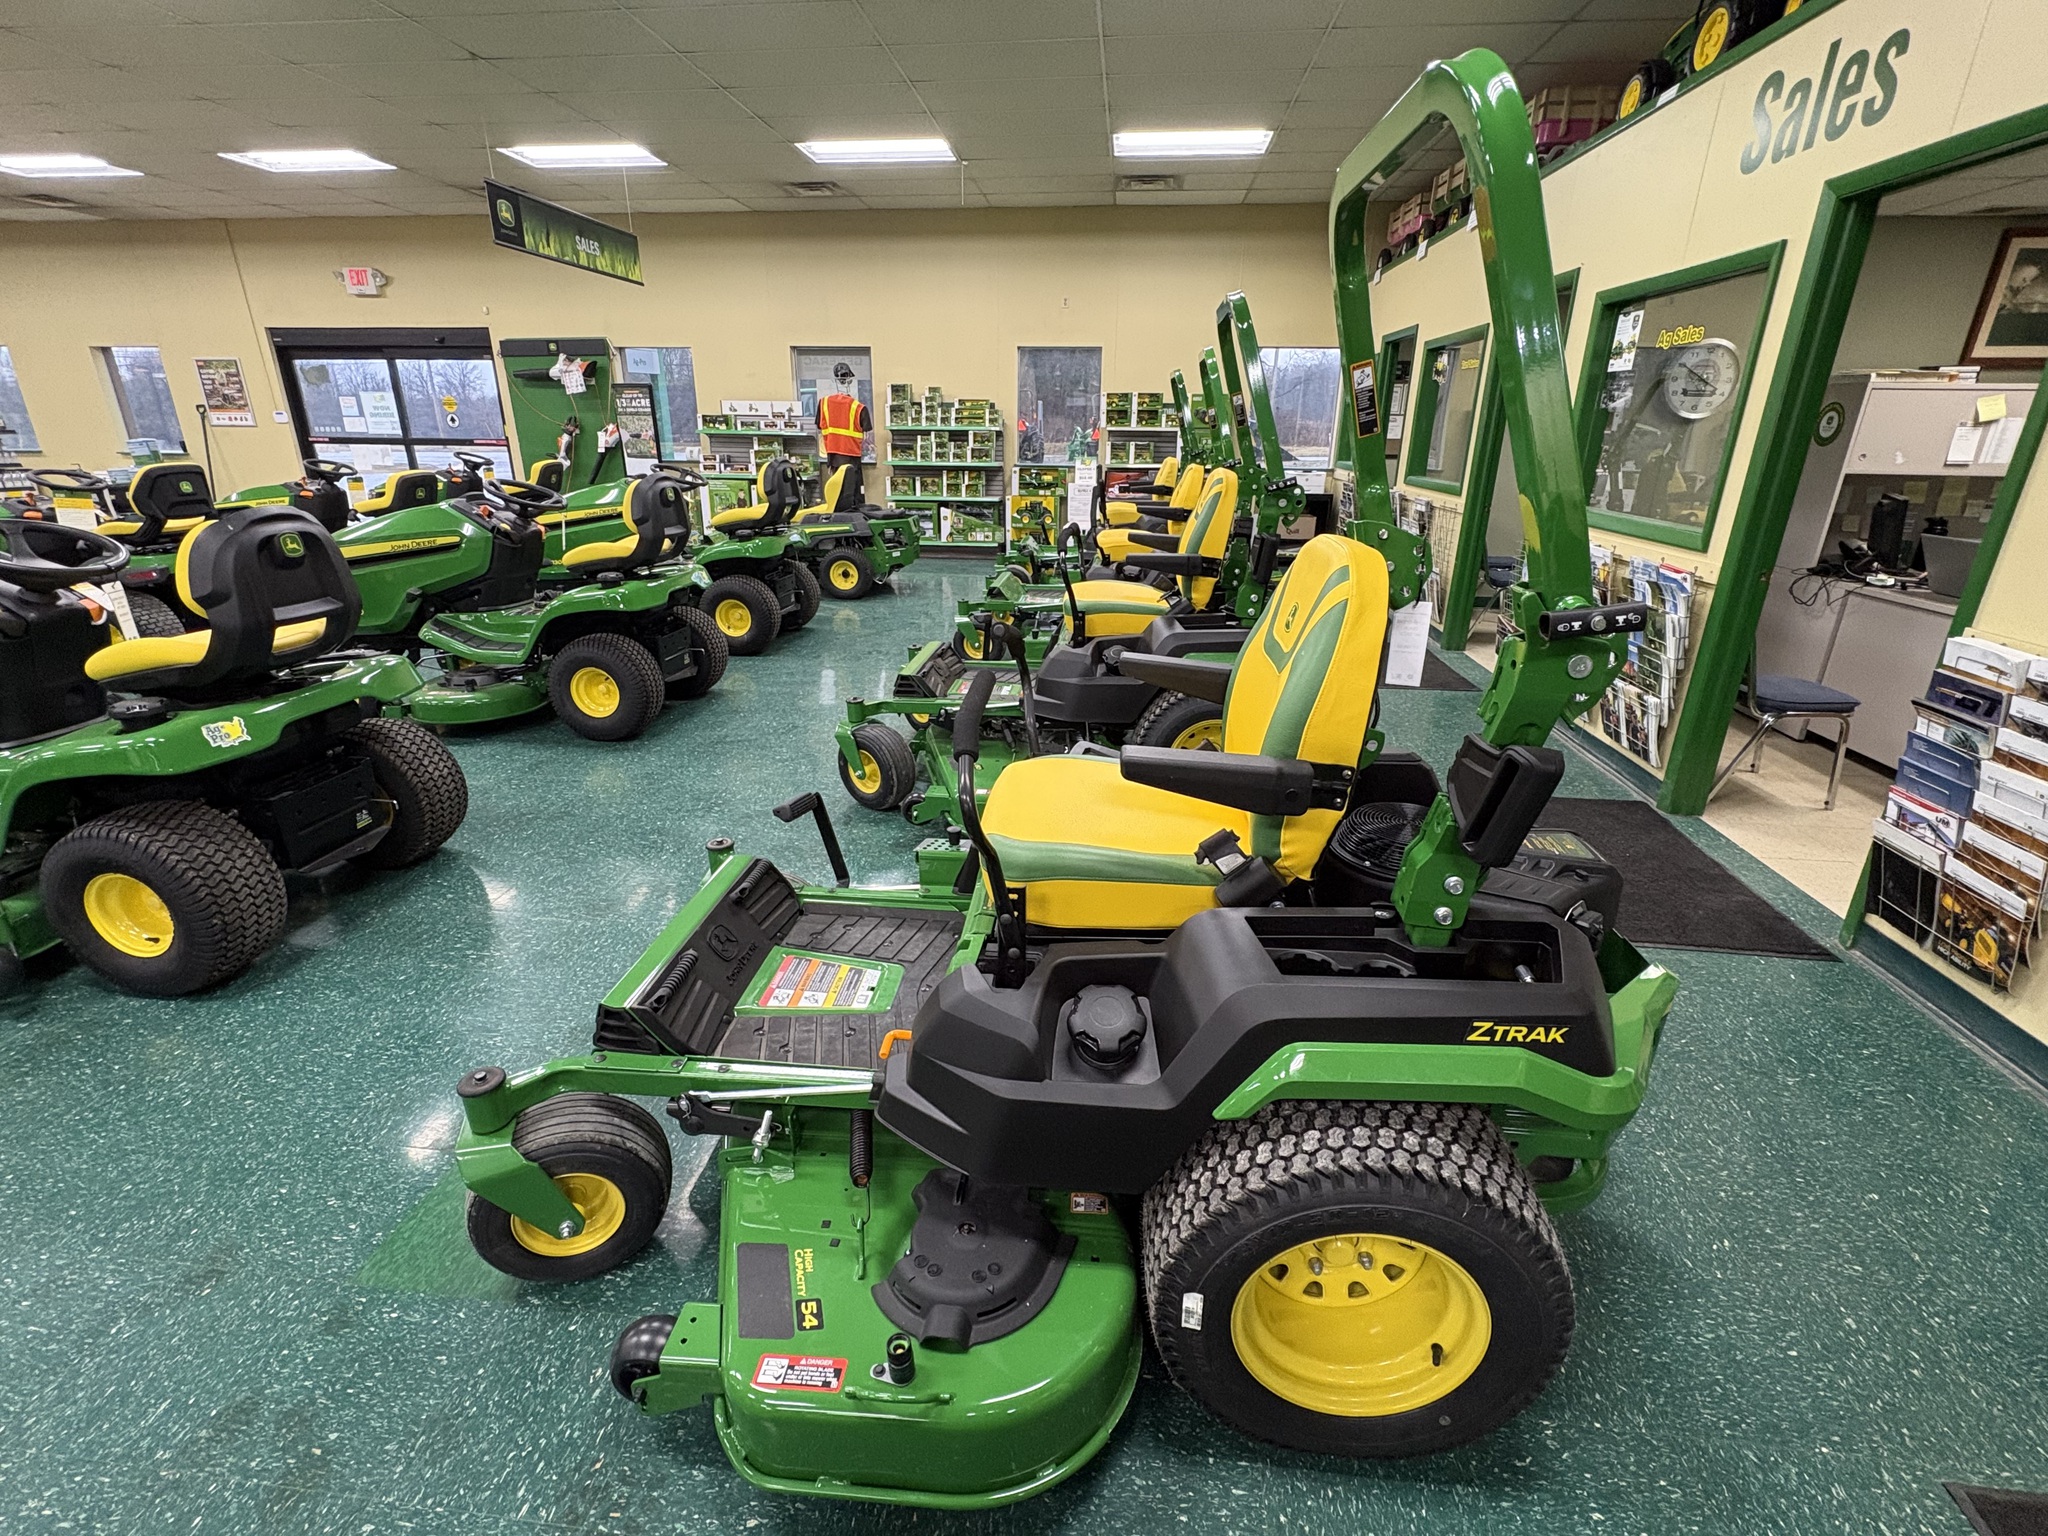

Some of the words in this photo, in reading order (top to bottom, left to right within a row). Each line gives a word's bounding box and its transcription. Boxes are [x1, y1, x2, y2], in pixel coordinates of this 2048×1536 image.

[1739, 28, 1911, 175] Sales
[575, 234, 601, 256] SALES
[348, 269, 369, 286] EXIT
[1656, 329, 1673, 350] Ag
[1673, 324, 1705, 345] Sales
[631, 398, 651, 407] ACRE
[389, 543, 410, 552] JOHN
[411, 539, 438, 549] DEERE
[211, 732, 230, 744] Pro
[1466, 1021, 1570, 1044] ZTRAK
[803, 1248, 814, 1273] HIGH
[794, 1249, 807, 1297] CAPACITY
[801, 1301, 819, 1330] 54
[807, 1358, 834, 1366] DANGER
